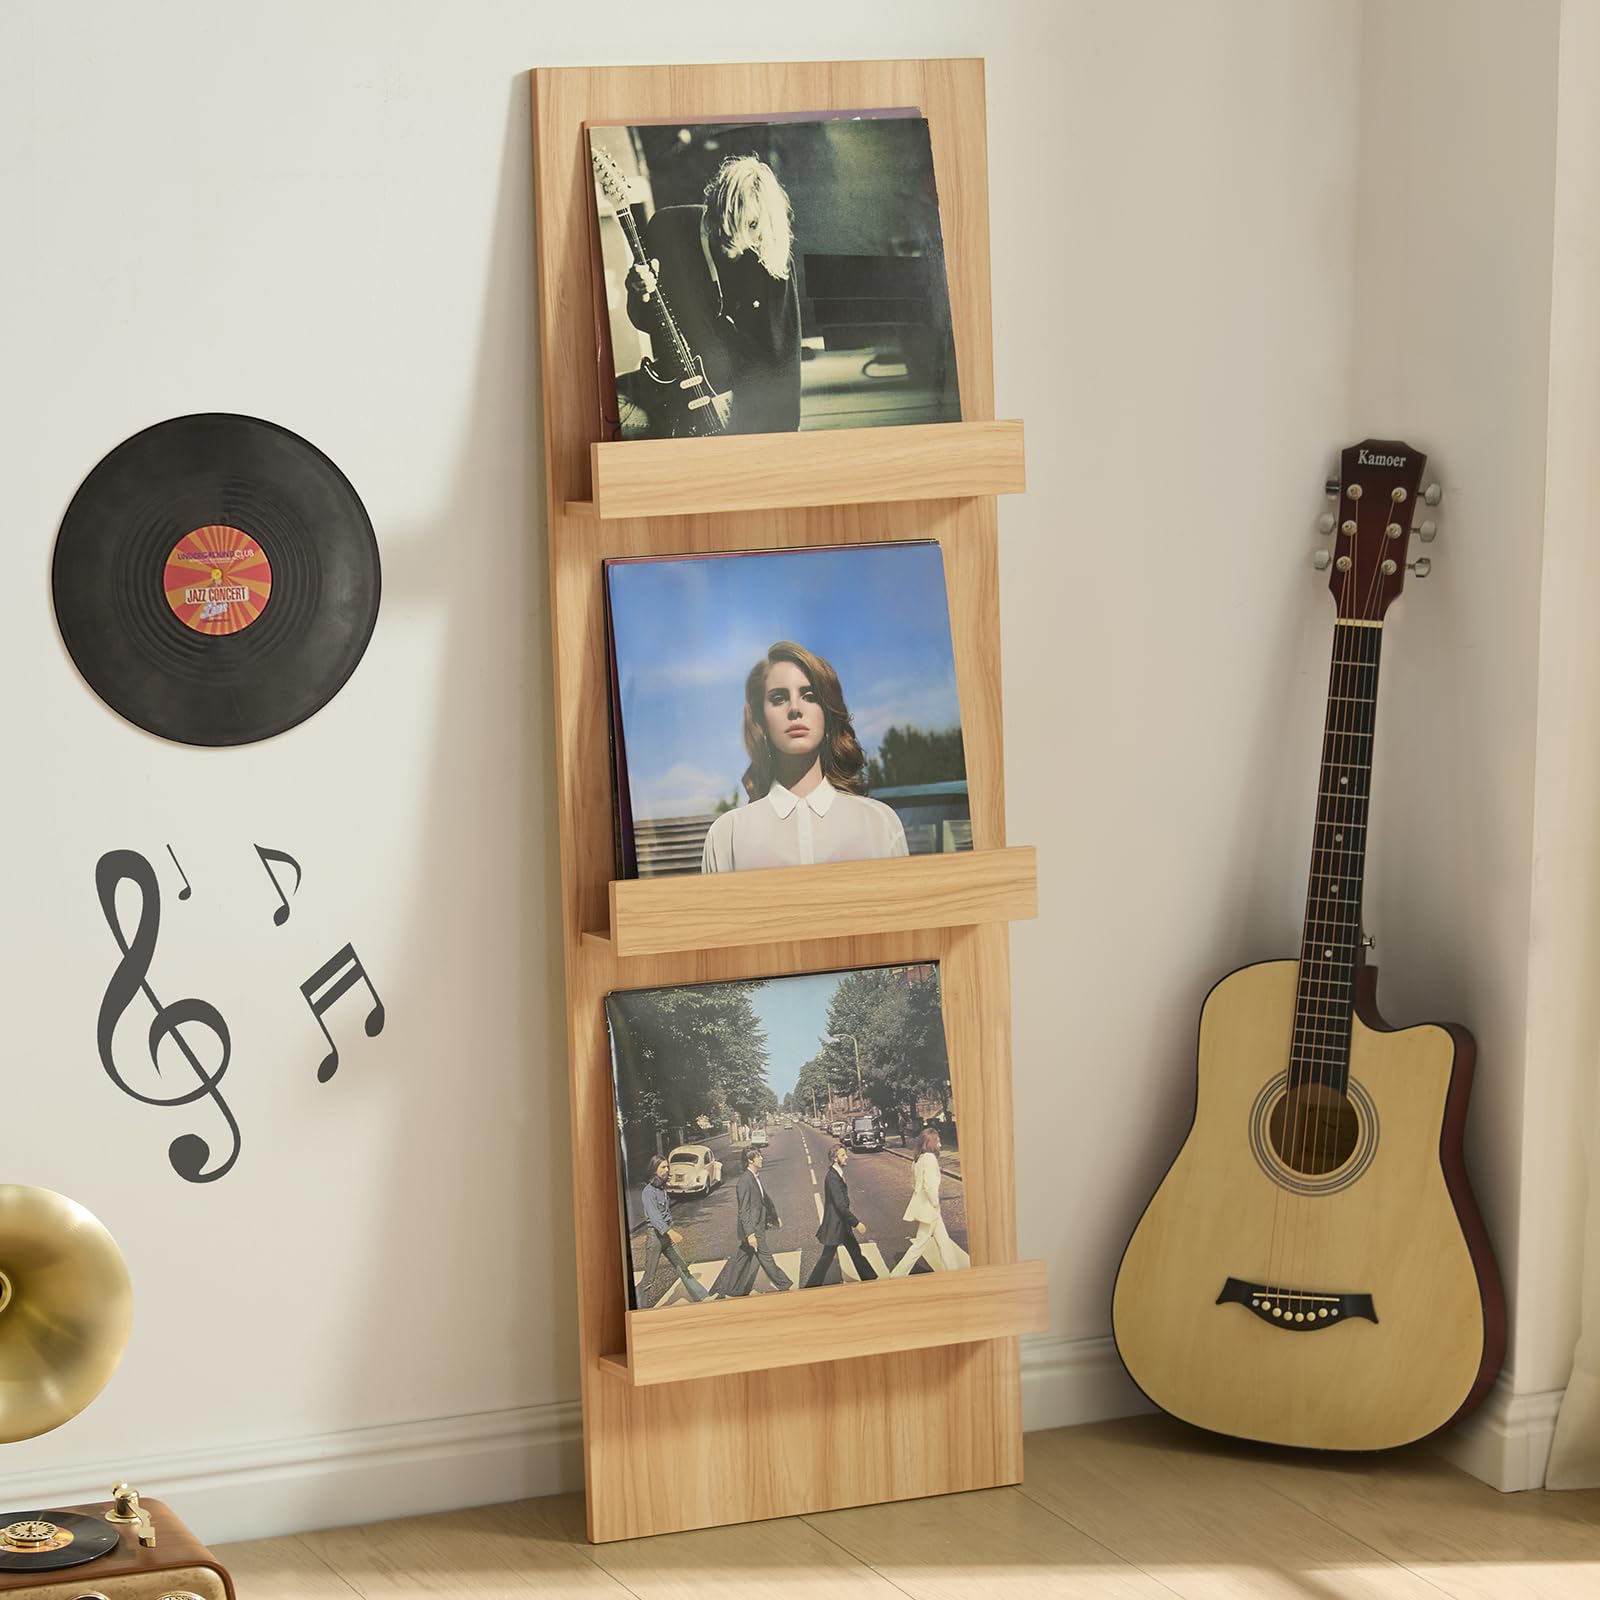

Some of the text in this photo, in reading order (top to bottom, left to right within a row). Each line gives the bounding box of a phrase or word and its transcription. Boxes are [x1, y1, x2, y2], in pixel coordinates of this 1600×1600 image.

[1358, 449, 1406, 467] Kamoer
[187, 587, 246, 602] JAZZ CONCERT
